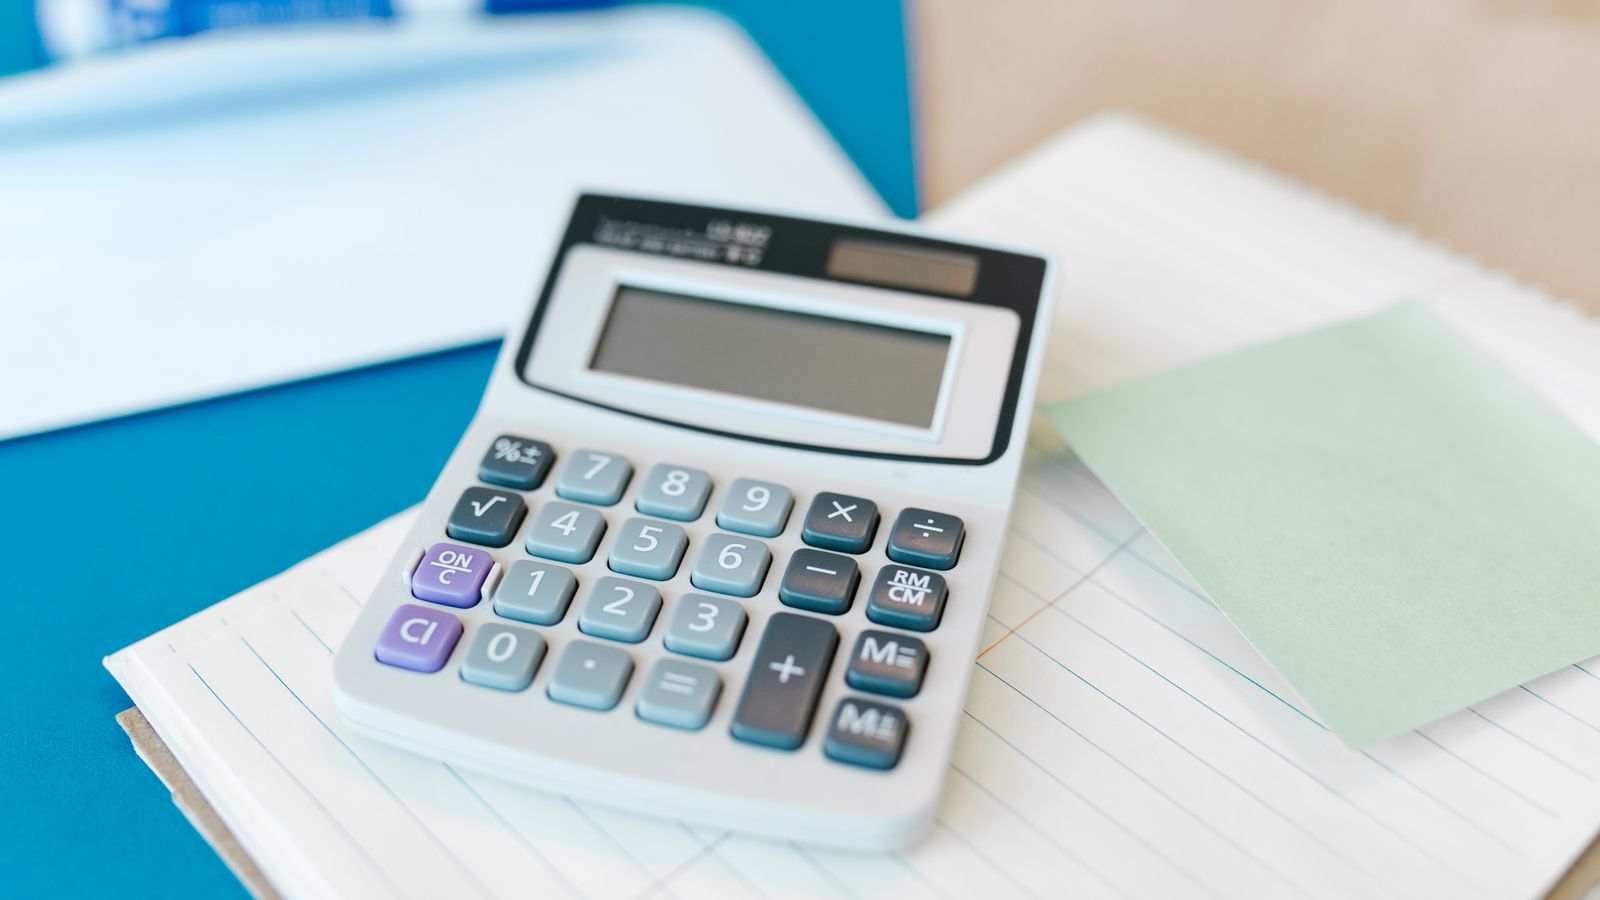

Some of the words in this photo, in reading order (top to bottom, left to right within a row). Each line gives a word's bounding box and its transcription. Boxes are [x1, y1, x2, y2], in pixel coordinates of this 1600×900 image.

[584, 455, 612, 480] 7
[660, 470, 691, 497] 8
[742, 486, 770, 512] 9
[551, 511, 580, 536] 4
[633, 526, 663, 552] 5
[438, 551, 473, 568] ON
[718, 543, 747, 570] 6
[438, 569, 456, 585] C
[528, 570, 546, 597] 1
[893, 569, 931, 589] RM
[603, 586, 634, 616] 2
[888, 588, 926, 606] CM
[688, 603, 720, 632] 3
[769, 655, 805, 684] +
